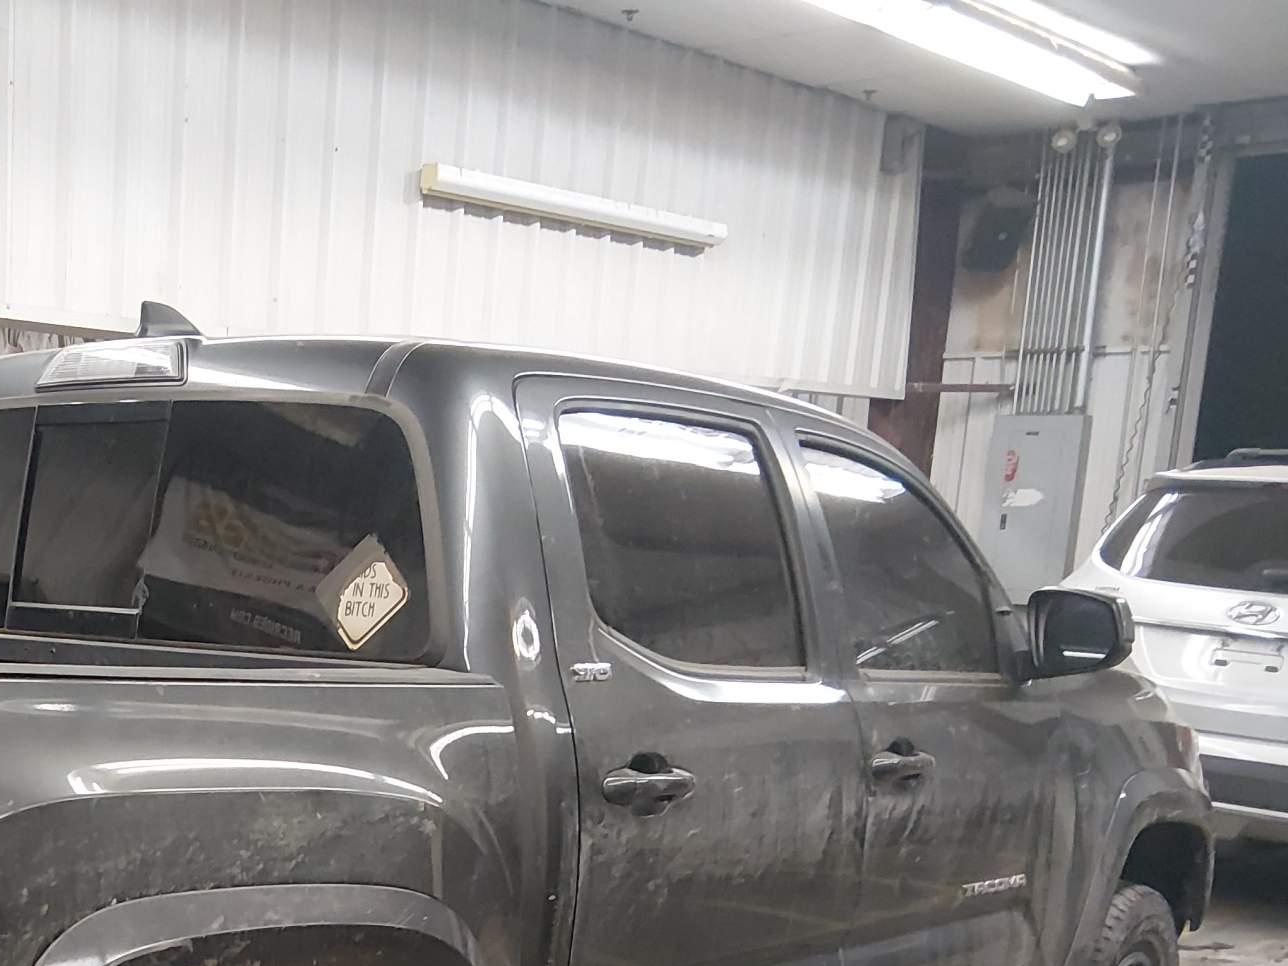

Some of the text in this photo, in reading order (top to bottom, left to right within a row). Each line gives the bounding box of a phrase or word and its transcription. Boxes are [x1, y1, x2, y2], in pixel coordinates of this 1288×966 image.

[352, 582, 390, 599] IN THIS
[344, 600, 375, 617] BITCH
[962, 873, 1027, 897] TACOMA
